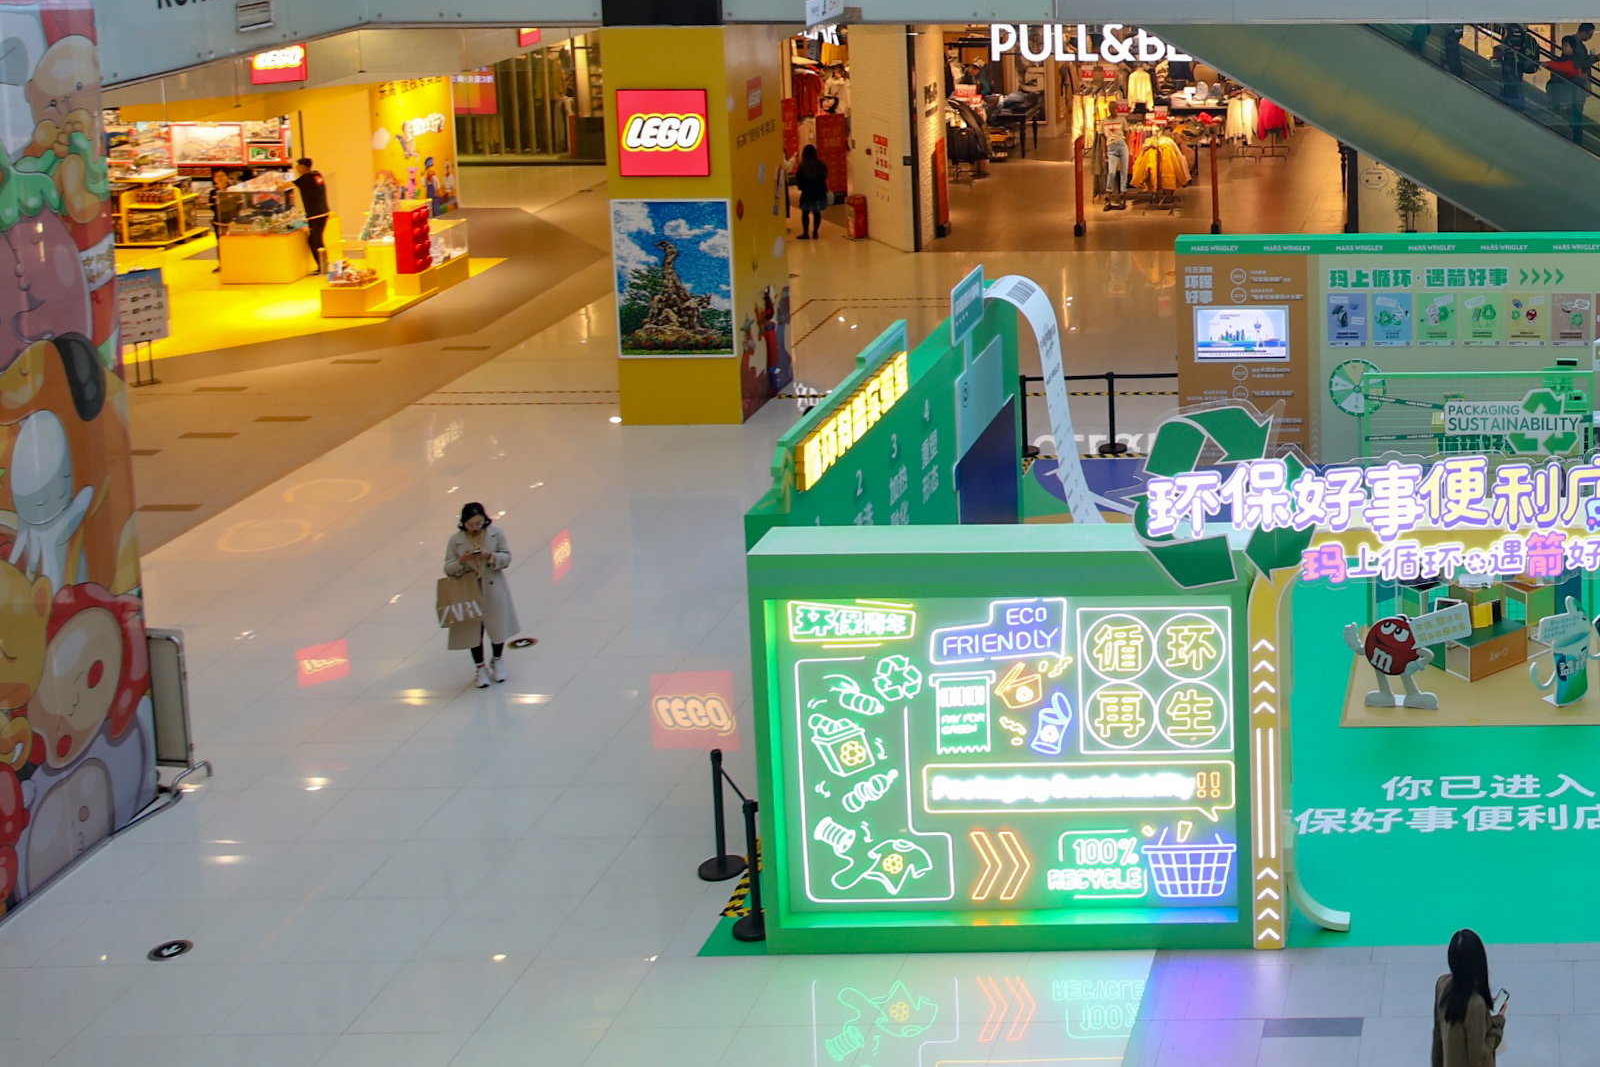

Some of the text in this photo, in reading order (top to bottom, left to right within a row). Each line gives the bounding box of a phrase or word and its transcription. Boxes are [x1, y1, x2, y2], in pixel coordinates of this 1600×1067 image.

[625, 115, 702, 149] LEGO
[1191, 244, 1239, 252] MARS WRIGLEY
[1264, 244, 1310, 252] MARS WRIGLEY
[1336, 244, 1384, 252] MARS WRIGLEY
[1408, 244, 1456, 252] MARS WRIGLEY
[1448, 405, 1520, 416] PACKAGING
[1447, 416, 1580, 432] SUSTAINABILITY
[439, 598, 485, 630] ZARA
[1005, 606, 1048, 627] ECO
[941, 626, 1059, 656] FRIENDLY
[1092, 623, 1217, 672] 循环
[1094, 689, 1216, 739] 再生
[1382, 773, 1597, 802] 你已进入
[1072, 837, 1140, 866] 100%
[1046, 867, 1143, 891] RECYCLE
